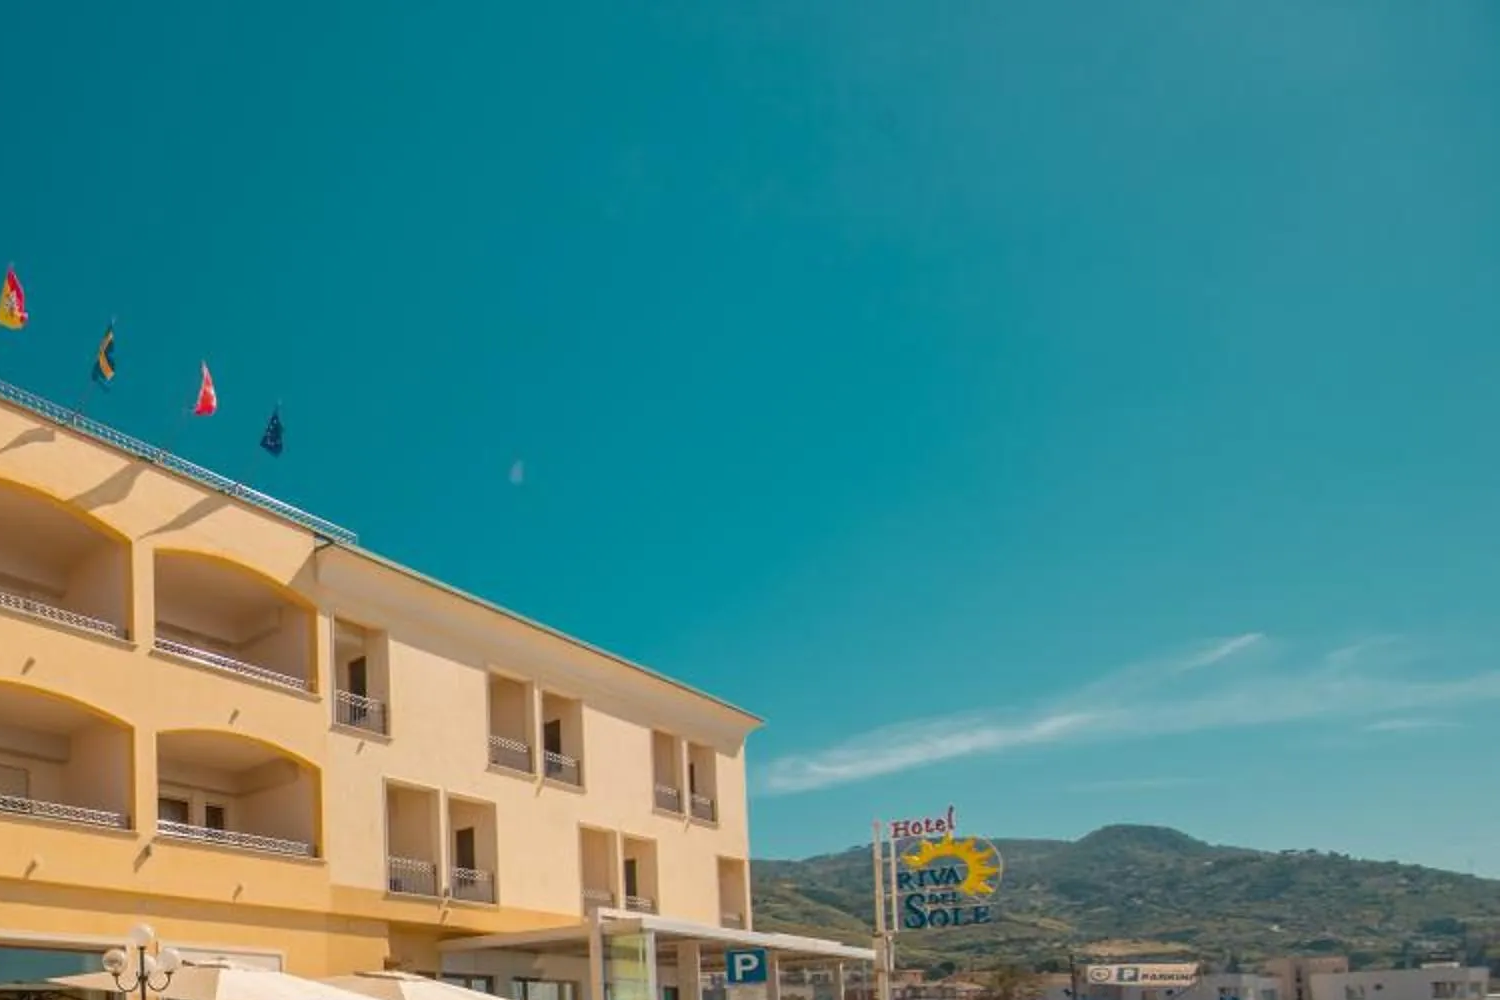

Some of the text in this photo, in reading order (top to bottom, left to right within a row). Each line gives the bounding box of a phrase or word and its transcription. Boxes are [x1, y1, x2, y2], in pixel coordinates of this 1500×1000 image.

[890, 803, 954, 838] Hotel
[898, 865, 962, 889] RIVA
[734, 953, 759, 981] P
